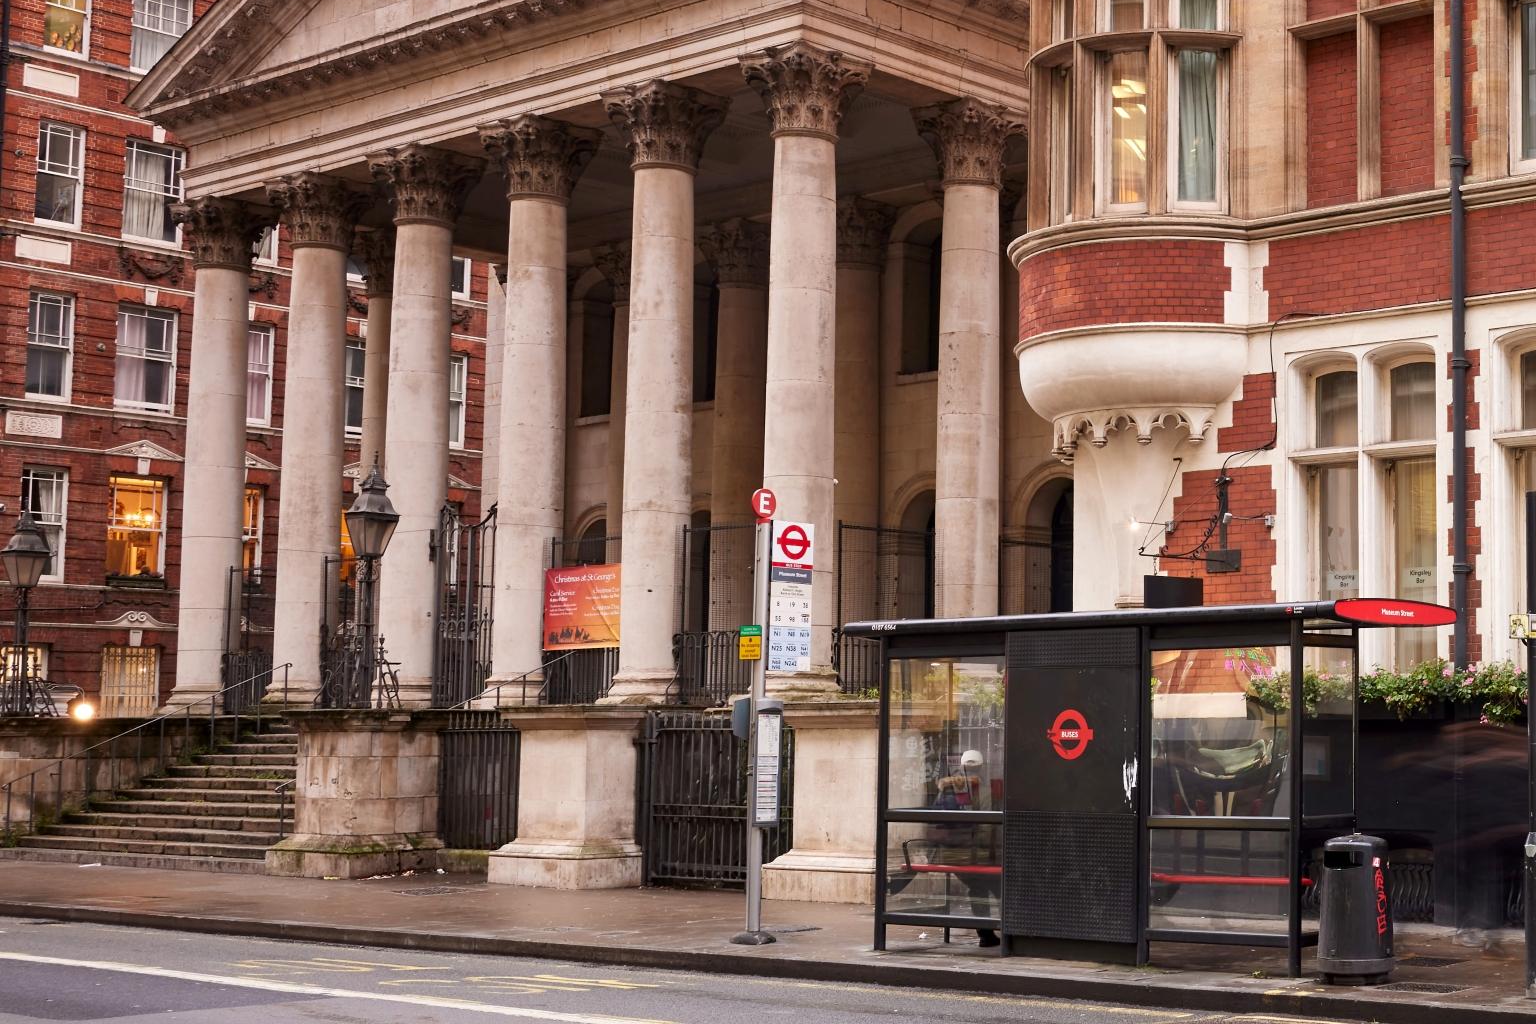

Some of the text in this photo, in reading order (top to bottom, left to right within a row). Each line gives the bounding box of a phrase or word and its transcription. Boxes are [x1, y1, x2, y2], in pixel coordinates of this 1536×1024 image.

[760, 492, 771, 514] E
[1410, 569, 1431, 577] Kingsley
[554, 573, 580, 583] Christmas
[1381, 608, 1414, 617] Museum Street
